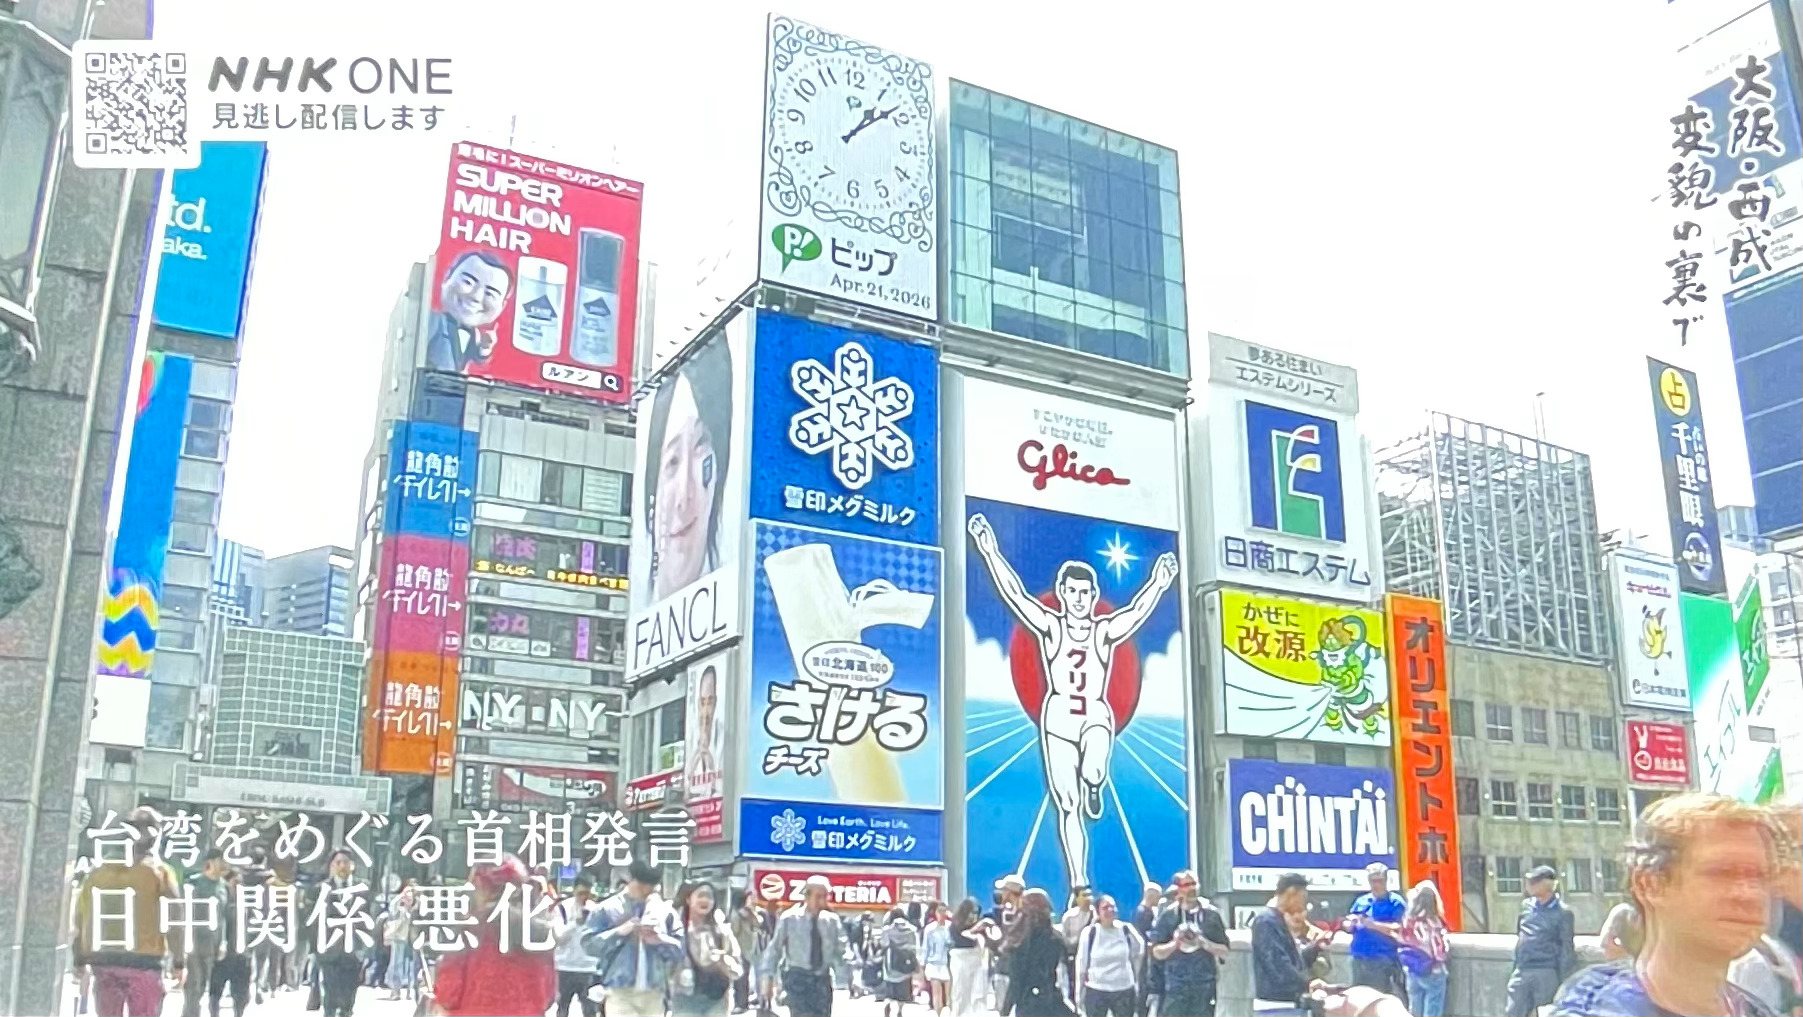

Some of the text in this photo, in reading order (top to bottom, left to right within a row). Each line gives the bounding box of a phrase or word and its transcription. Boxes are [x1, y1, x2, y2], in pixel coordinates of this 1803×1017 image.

[818, 67, 837, 87] 11
[846, 69, 865, 90] 12
[794, 78, 816, 103] 10
[877, 88, 887, 101] 1
[787, 108, 805, 125] 9
[892, 112, 910, 127] 2
[794, 140, 813, 154] 8
[900, 141, 917, 157] 3
[456, 163, 563, 207] SUPER
[819, 165, 836, 180] 7
[894, 165, 911, 183] 4
[847, 180, 859, 198] 6
[874, 179, 889, 198] 5
[453, 190, 571, 236] MILLION
[450, 216, 532, 254] HAIR
[831, 237, 898, 276] ピップ
[548, 366, 589, 382] ルアン
[1666, 371, 1686, 410] 占
[1017, 440, 1131, 490] Glico
[1671, 421, 1704, 527] 千里眼
[784, 485, 916, 526] 雪印メグミルク
[1225, 535, 1371, 586] 日商エステム
[633, 581, 727, 670] FANCL
[1243, 602, 1301, 627] かぜに
[1236, 625, 1307, 662] 改源
[1067, 648, 1087, 715] グリコ
[764, 680, 927, 751] さける
[762, 745, 829, 776] チーズ
[789, 879, 892, 903] ZTERIA
